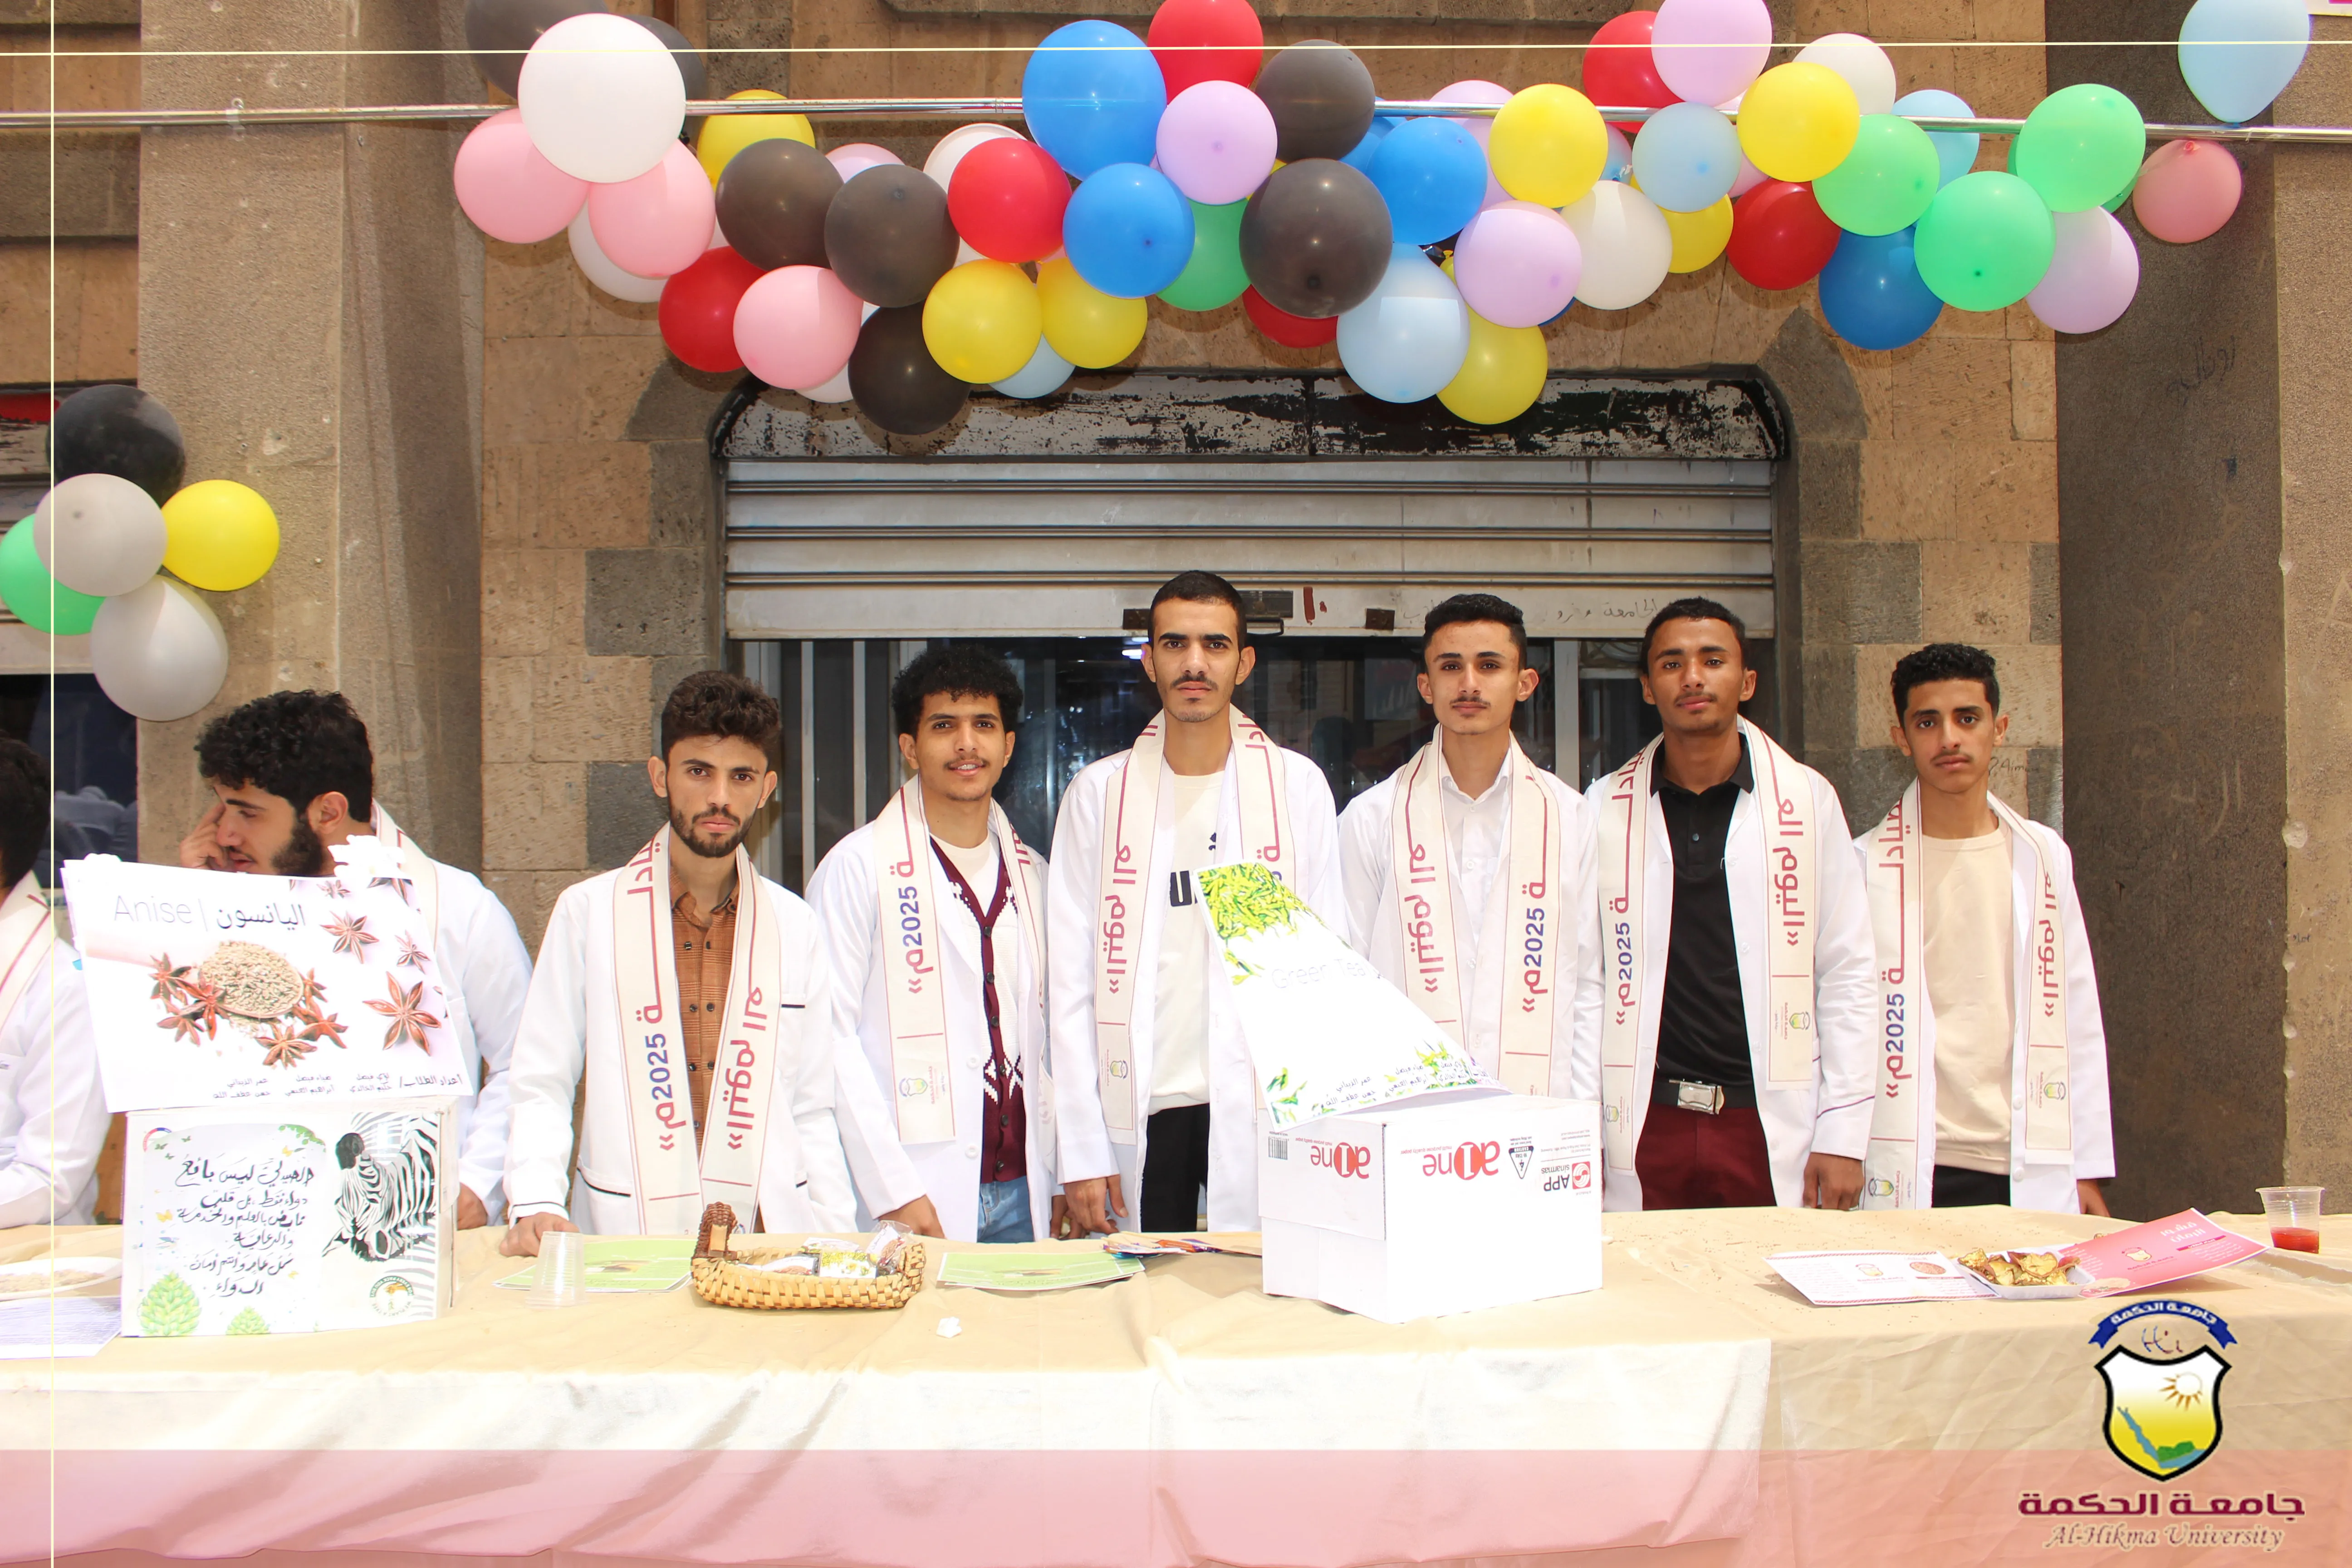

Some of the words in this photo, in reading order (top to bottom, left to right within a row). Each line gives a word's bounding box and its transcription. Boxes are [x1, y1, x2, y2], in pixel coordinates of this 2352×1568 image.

[114, 895, 192, 924] Anise
[216, 902, 306, 931] اليانسون
[1272, 965, 1332, 989] Green
[1333, 958, 1366, 976] Tea
[1541, 1164, 1570, 1174] sinarmas
[1544, 1174, 1570, 1192] APP
